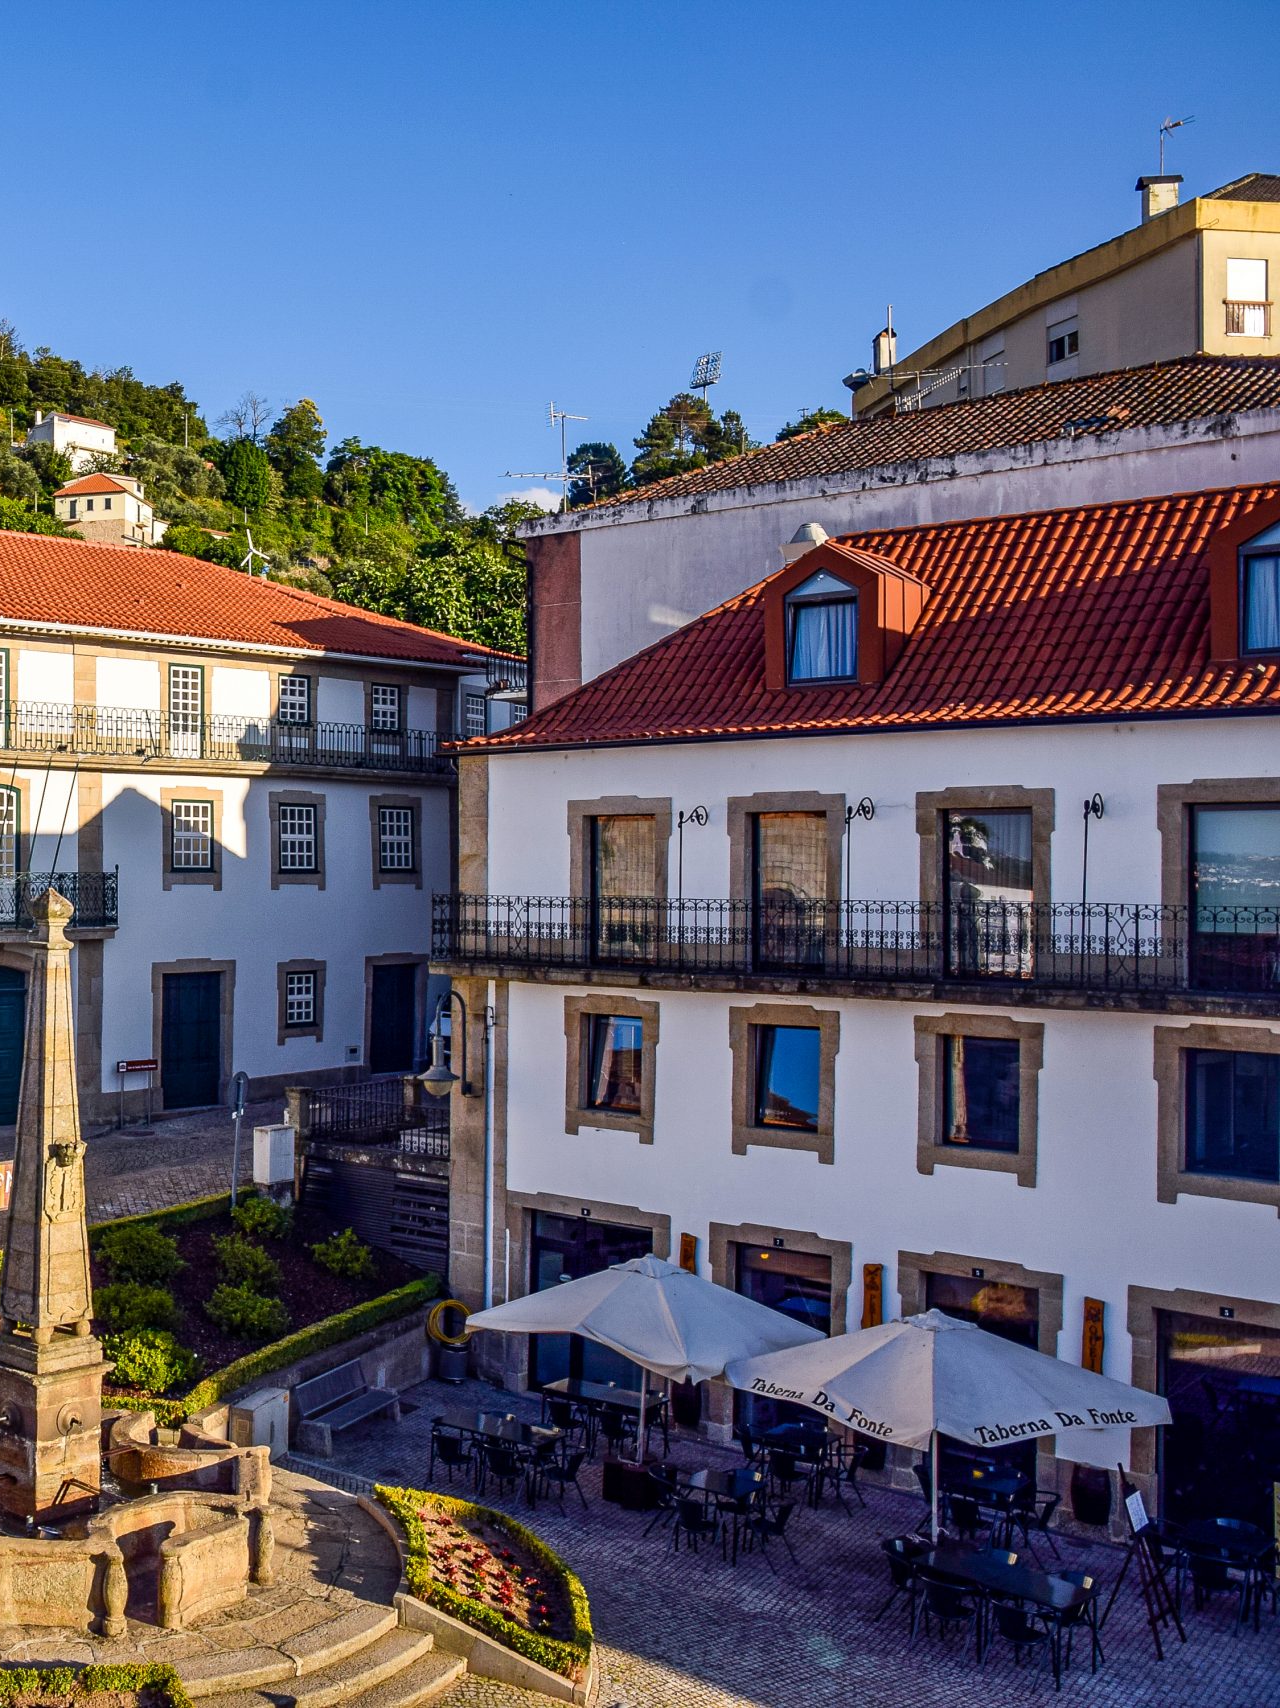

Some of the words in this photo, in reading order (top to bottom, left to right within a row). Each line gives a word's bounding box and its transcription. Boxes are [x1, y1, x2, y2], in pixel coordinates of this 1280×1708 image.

[750, 1377, 805, 1400] Taberna
[811, 1390, 836, 1413] Da
[846, 1407, 893, 1438] Fonte
[974, 1418, 1053, 1445] Taberna
[1054, 1411, 1086, 1427] Da
[1086, 1408, 1138, 1425] Fonte
